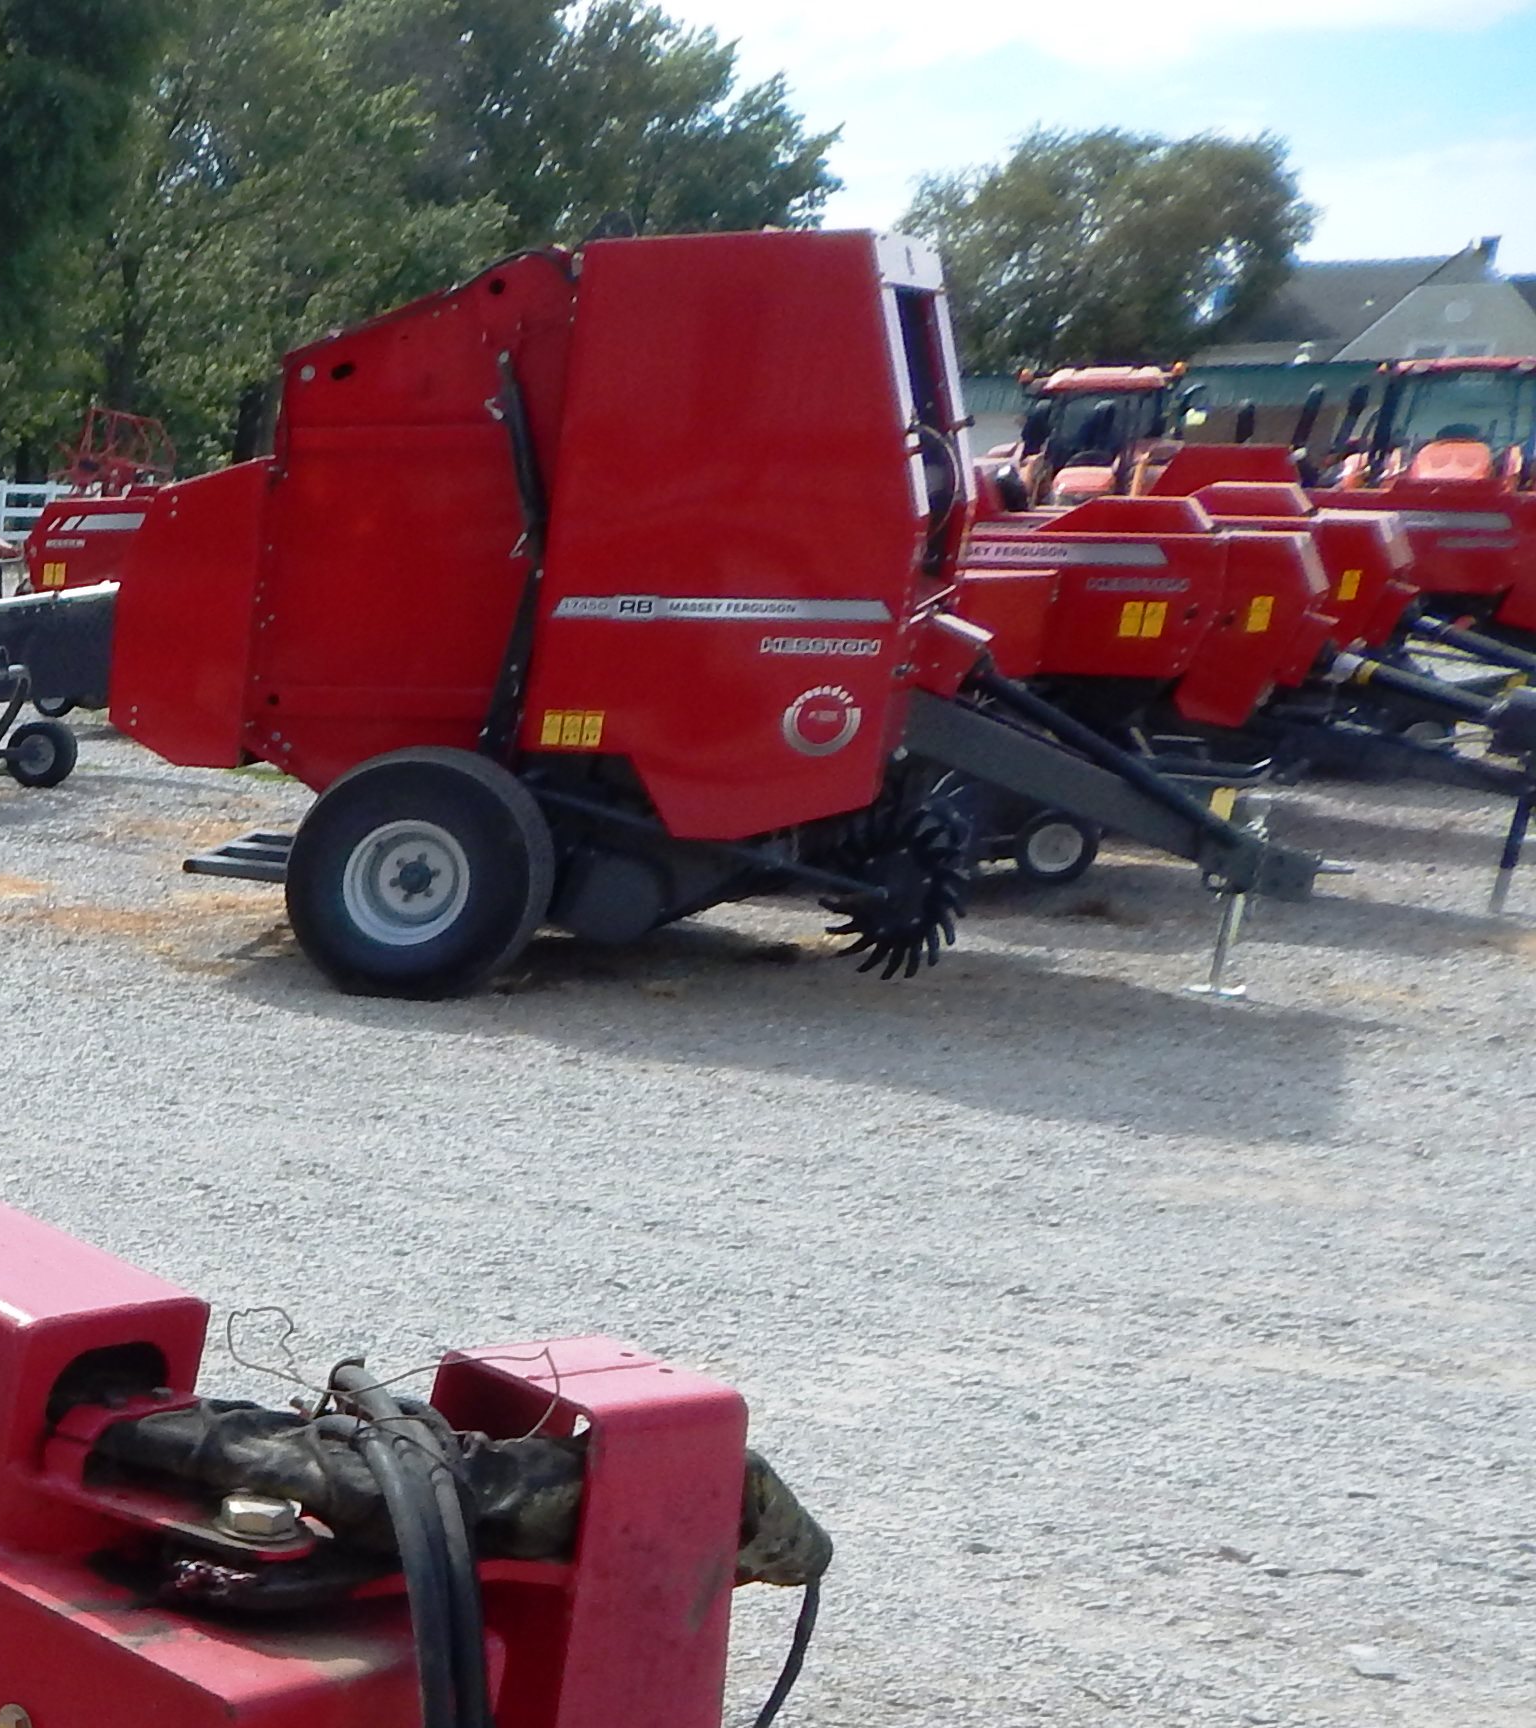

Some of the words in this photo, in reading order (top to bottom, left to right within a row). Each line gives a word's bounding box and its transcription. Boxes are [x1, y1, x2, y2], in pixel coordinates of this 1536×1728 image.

[619, 600, 653, 614] RB
[669, 601, 722, 612] MASSEY
[725, 602, 796, 614] FERGUSON
[760, 636, 881, 655] HESSTON
